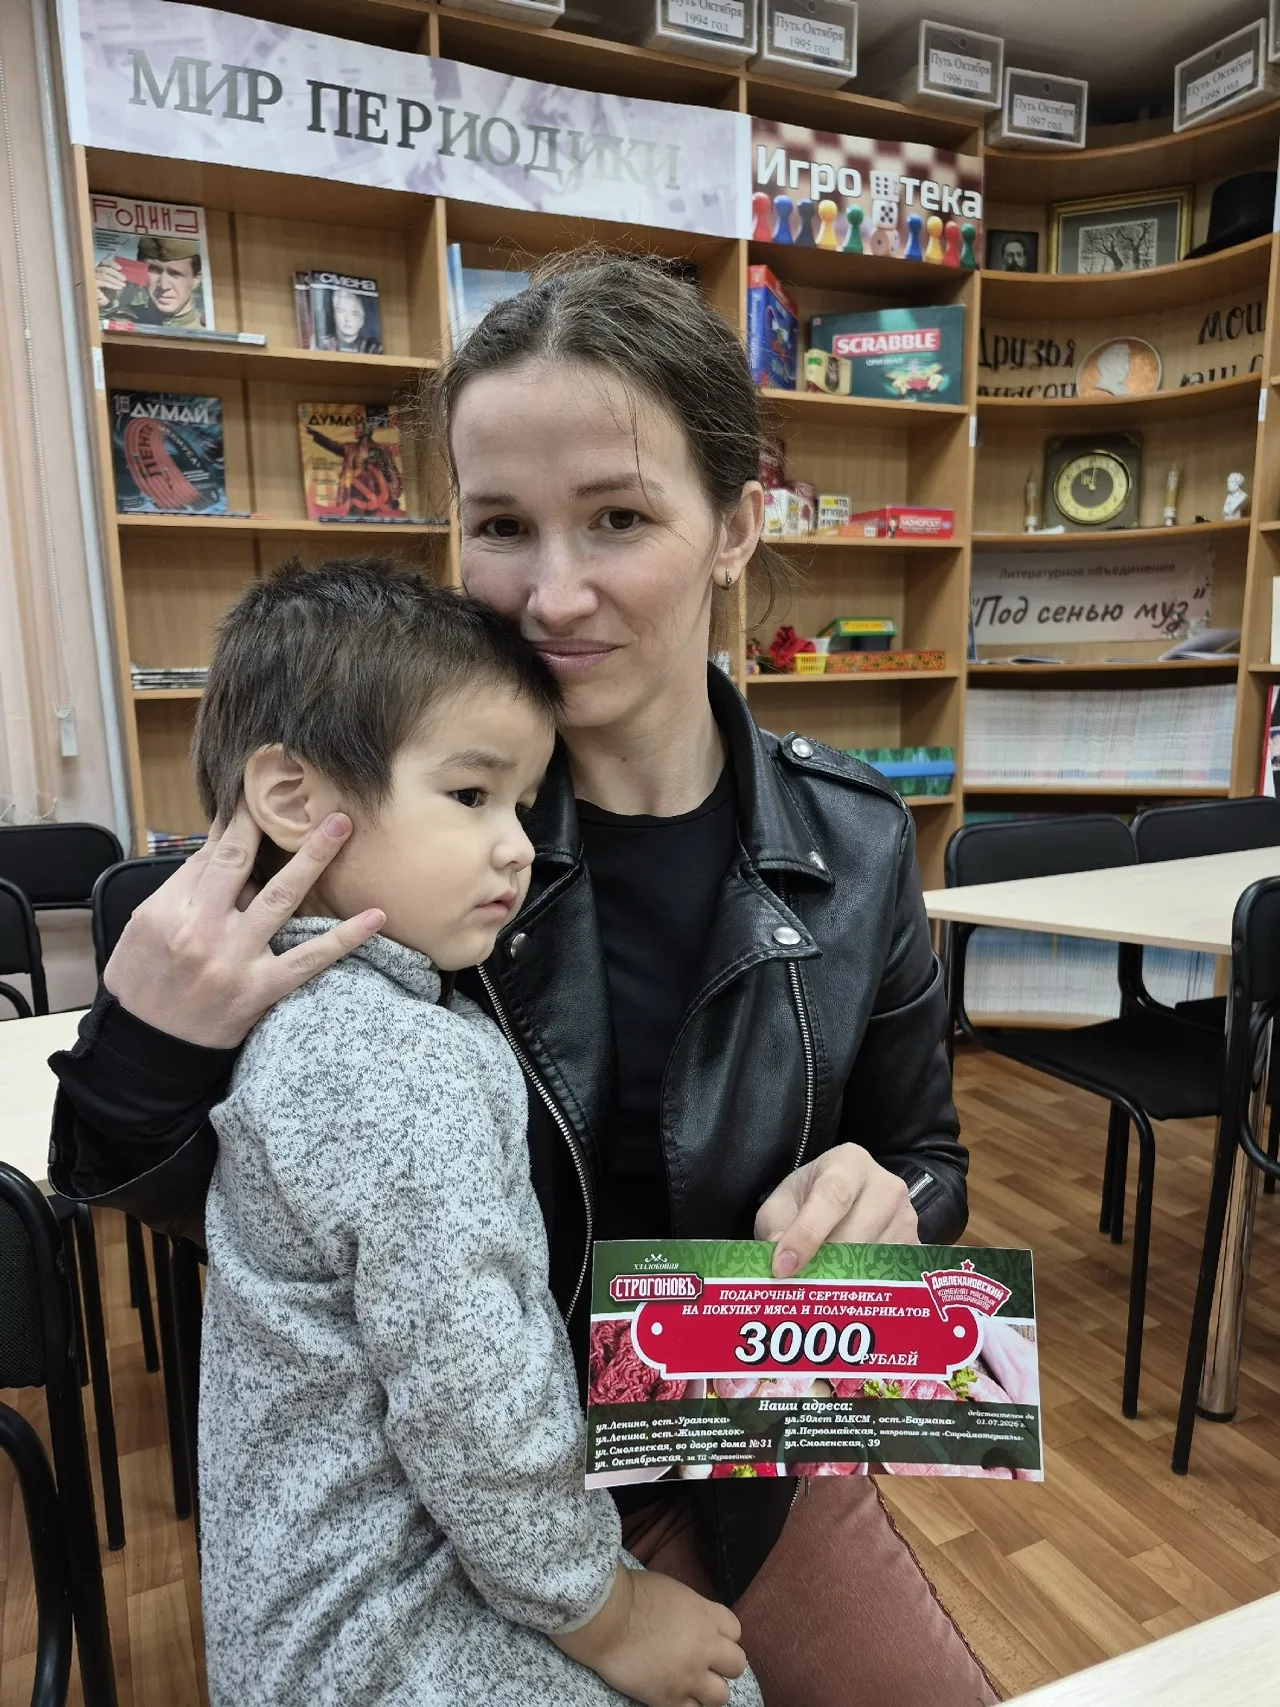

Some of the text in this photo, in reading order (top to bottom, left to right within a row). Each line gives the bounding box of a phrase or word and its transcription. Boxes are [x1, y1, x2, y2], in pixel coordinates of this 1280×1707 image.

[685, 12, 729, 33] 1994 год
[775, 15, 844, 42] Путь Октября
[789, 35, 830, 56] 1995 год
[931, 53, 991, 77] Путь Октября
[942, 71, 979, 89] 1996 год
[127, 47, 682, 191] МИР ПЕРИОДИКИ
[1014, 98, 1076, 120] Путь Октября
[1026, 115, 1063, 132] 1997 год
[836, 332, 937, 354] SCRABBLE
[130, 402, 210, 424] ДУМАЙ
[999, 563, 1176, 581] Литературное объединение
[1037, 602, 1124, 625] сенью
[615, 1276, 696, 1298] СТРОГОНОВЪ
[719, 1287, 893, 1302] ПОДАРОЧНЫЙ СЕРТИФИКАТ
[931, 1275, 1005, 1301] ДАВЛЕКАНОВСКИЙ
[681, 1304, 931, 1318] НА ПОКУПКУ МЯСА И ПОЛУФАБРИКАТОВ
[734, 1319, 919, 1367] 3000 РУБЛЕЙ
[758, 1398, 854, 1414] Наши адреса:
[595, 1420, 650, 1434] ул.Ленина,
[784, 1426, 877, 1437] ул.Первомайская,
[594, 1443, 673, 1459] ул.Смоленская,
[689, 1439, 719, 1451] дворе
[720, 1439, 747, 1449] дома
[748, 1438, 773, 1448] №31
[595, 1433, 649, 1447] ул.Ленина,
[784, 1438, 881, 1449] ул.Смоленская, 39
[594, 1459, 609, 1471] ул.
[611, 1454, 685, 1467] Октябрьская,
